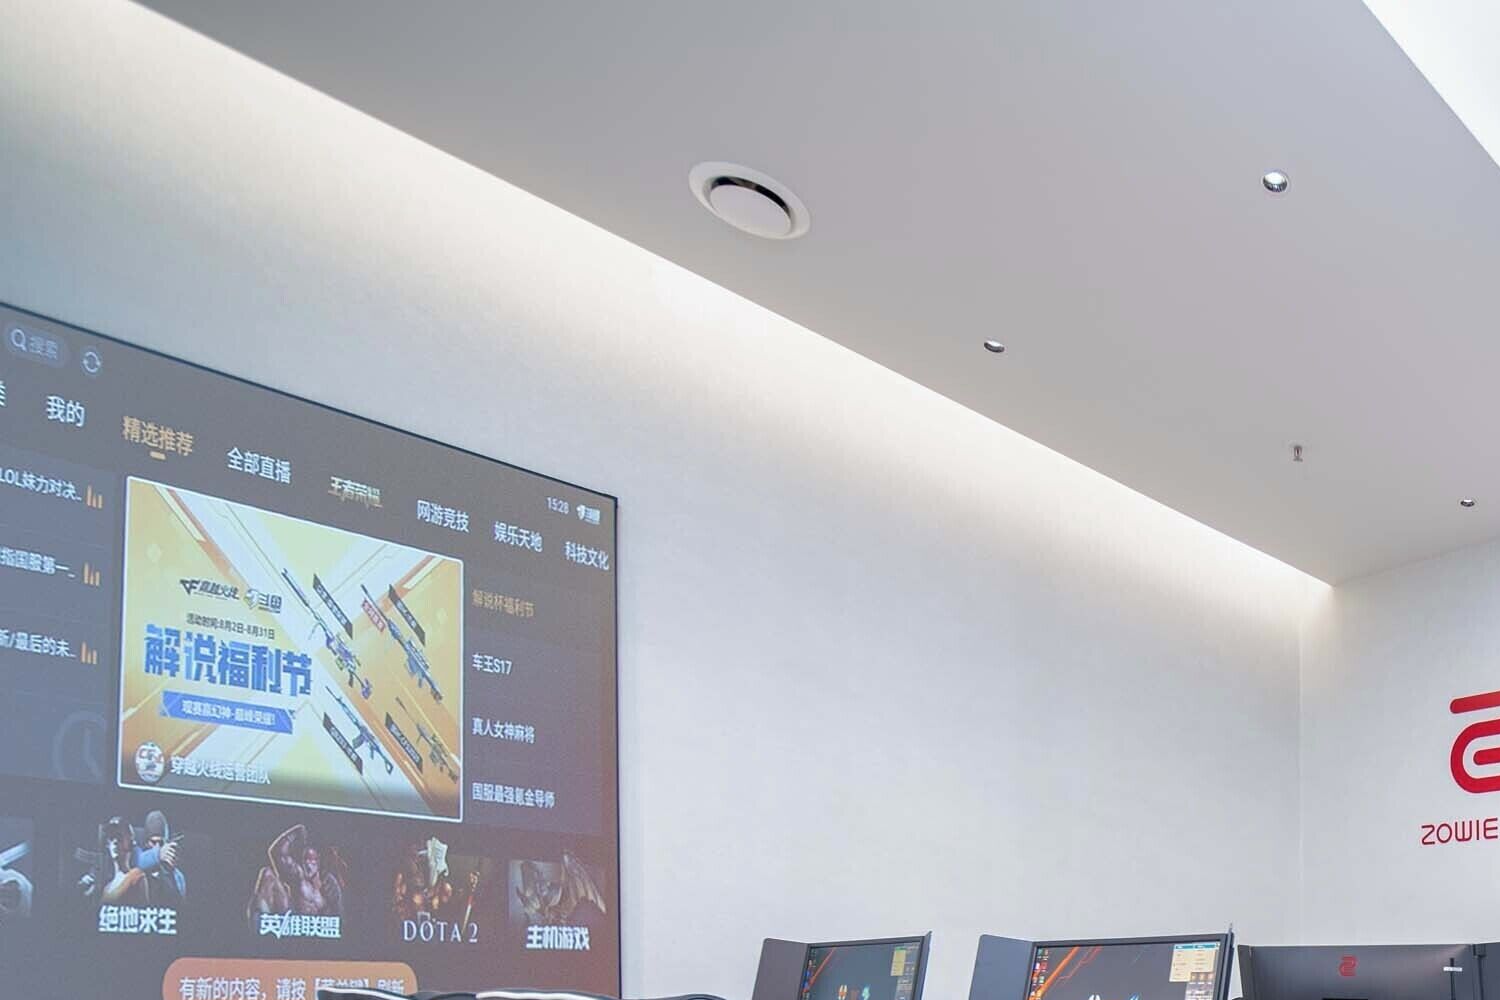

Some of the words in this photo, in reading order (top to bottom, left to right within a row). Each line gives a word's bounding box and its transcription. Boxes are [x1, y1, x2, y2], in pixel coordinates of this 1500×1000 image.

[46, 394, 86, 427] 我的
[122, 415, 194, 457] 精选推荐
[227, 447, 293, 485] 全部直播
[417, 500, 470, 533] 网游竞技
[494, 521, 544, 553] 娱乐天地
[564, 541, 611, 571] 科技文化
[144, 624, 313, 697] 解说福利节
[472, 653, 513, 675] 车王S17
[471, 717, 536, 745] 真人女神麻将
[1421, 817, 1499, 846] ZOWIE
[98, 905, 177, 935] 绝地求生
[259, 909, 342, 940] 英雄联盟
[403, 919, 463, 943] DOTA
[468, 922, 479, 943] 2
[526, 925, 590, 951] 主机游戏
